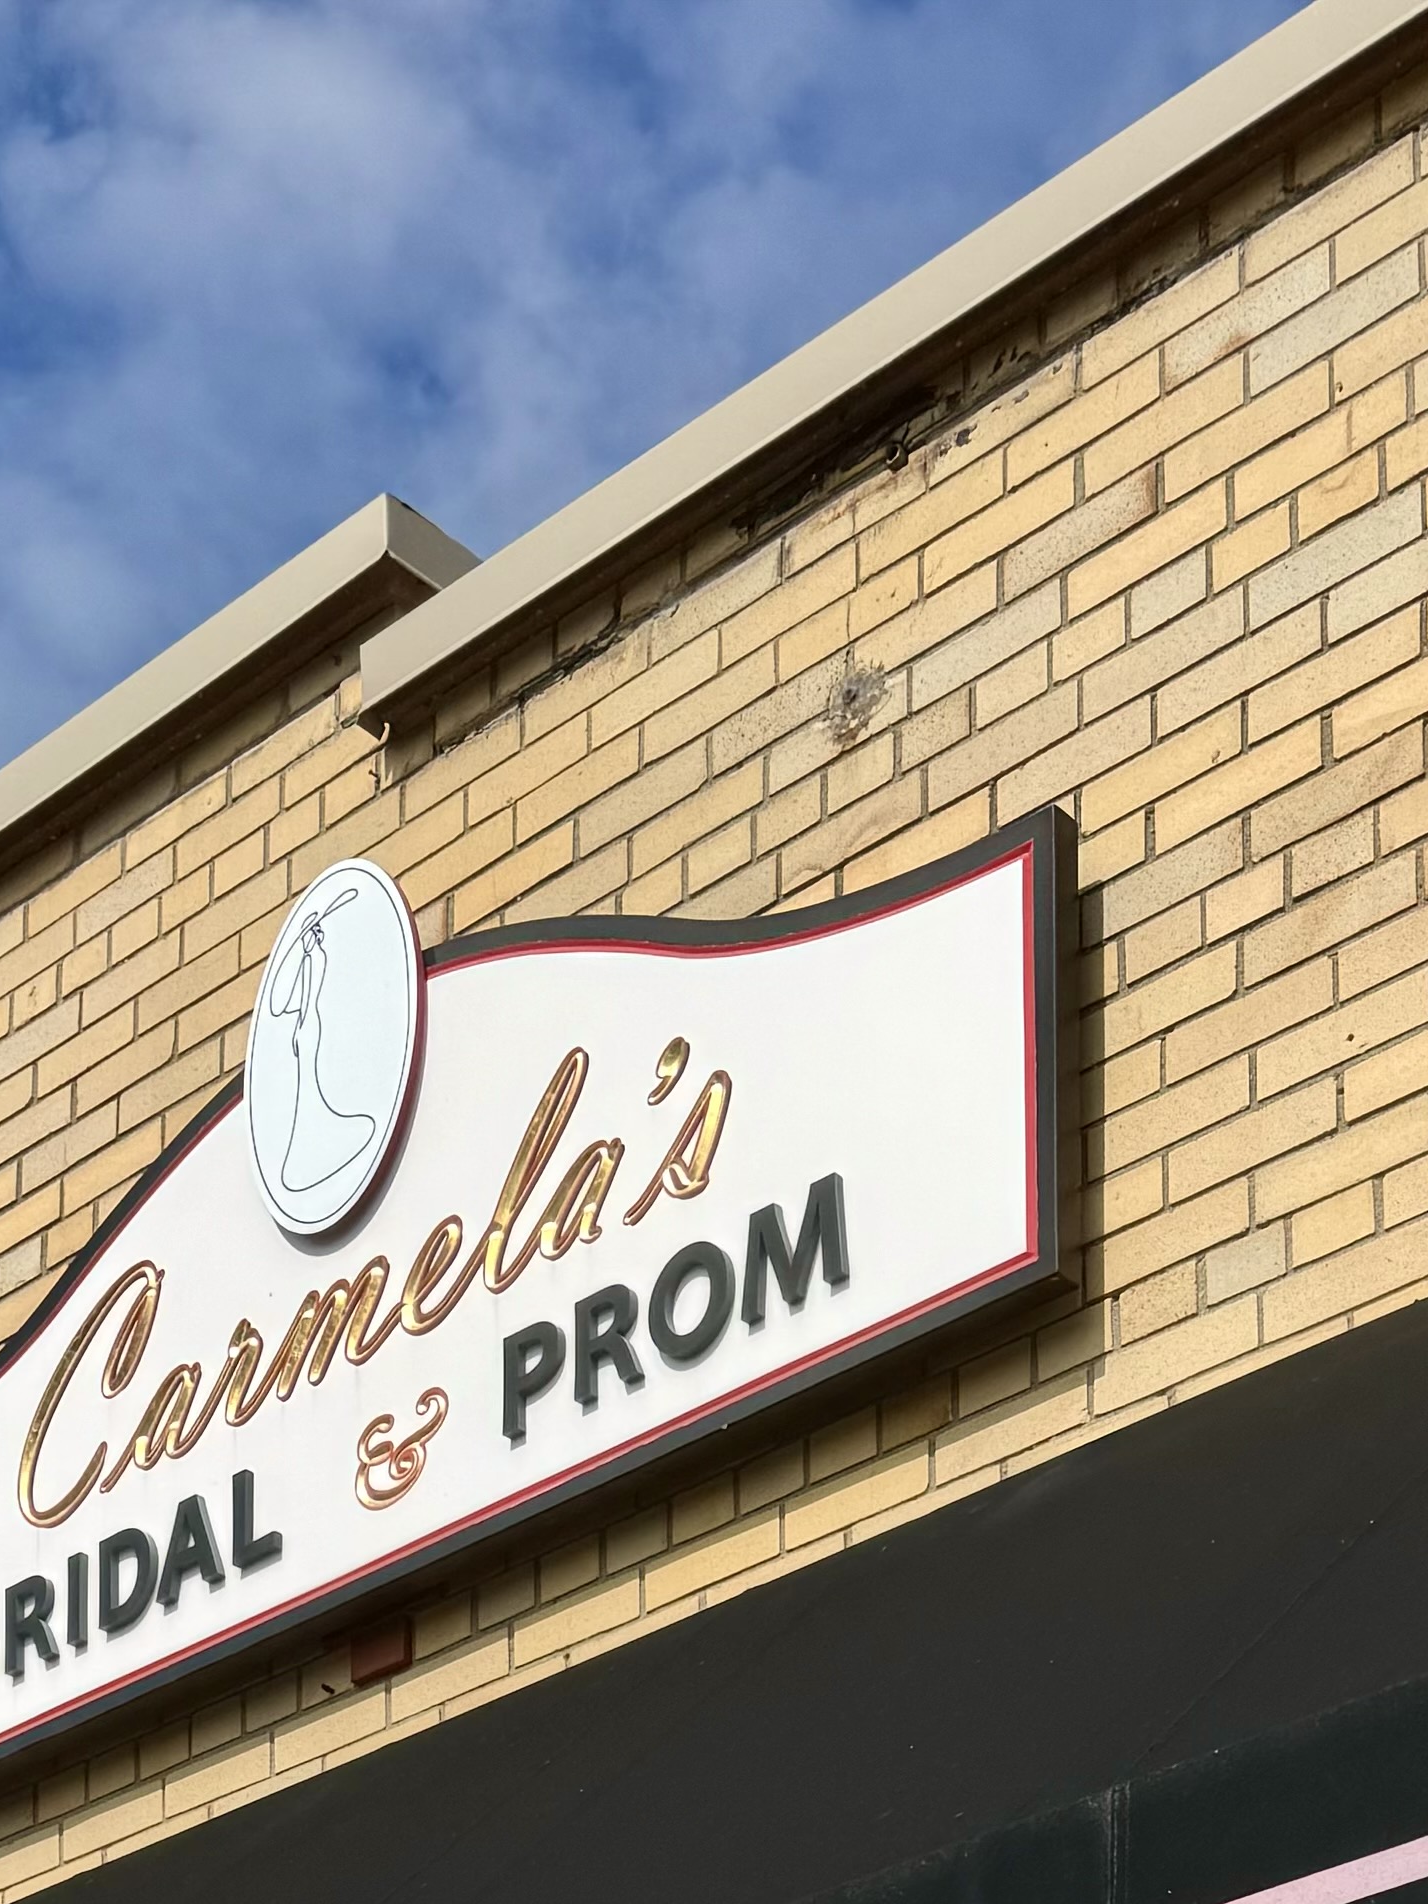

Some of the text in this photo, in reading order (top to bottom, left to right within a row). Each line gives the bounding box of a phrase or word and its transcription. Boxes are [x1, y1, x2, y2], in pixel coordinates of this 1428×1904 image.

[16, 1036, 733, 1529] Carmela's
[355, 1386, 449, 1512] &
[501, 1172, 850, 1448] PROM
